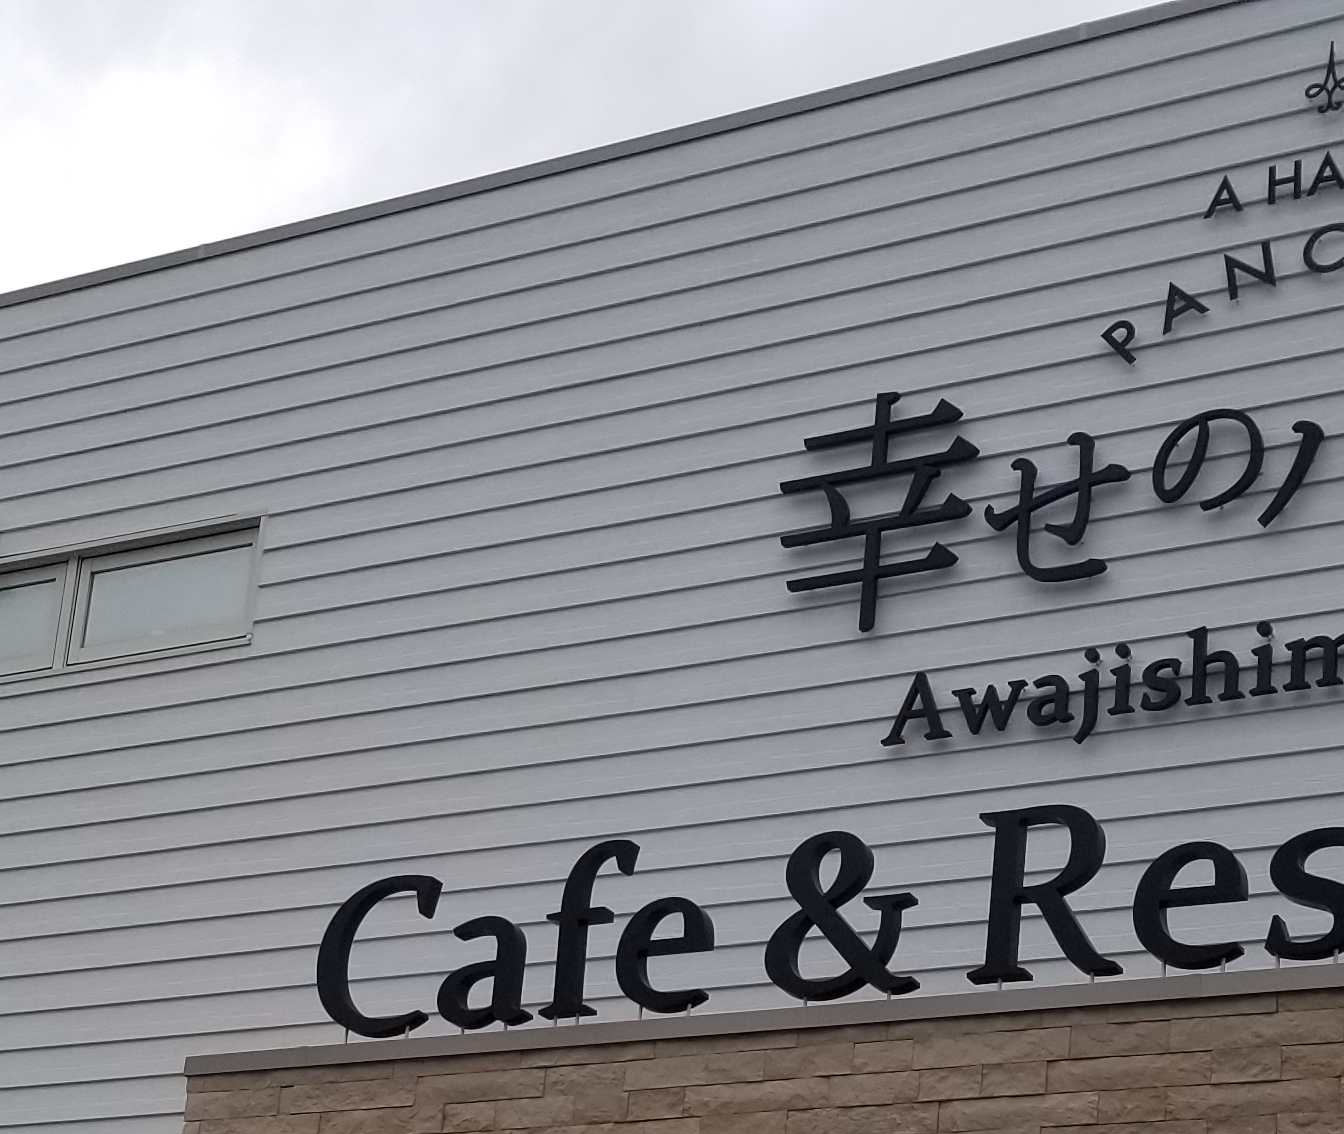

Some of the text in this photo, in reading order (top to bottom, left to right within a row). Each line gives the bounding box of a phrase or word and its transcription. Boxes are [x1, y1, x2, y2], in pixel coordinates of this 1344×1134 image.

[1204, 174, 1246, 219] A
[316, 838, 716, 1038] Cafe
[764, 830, 920, 1000] &
